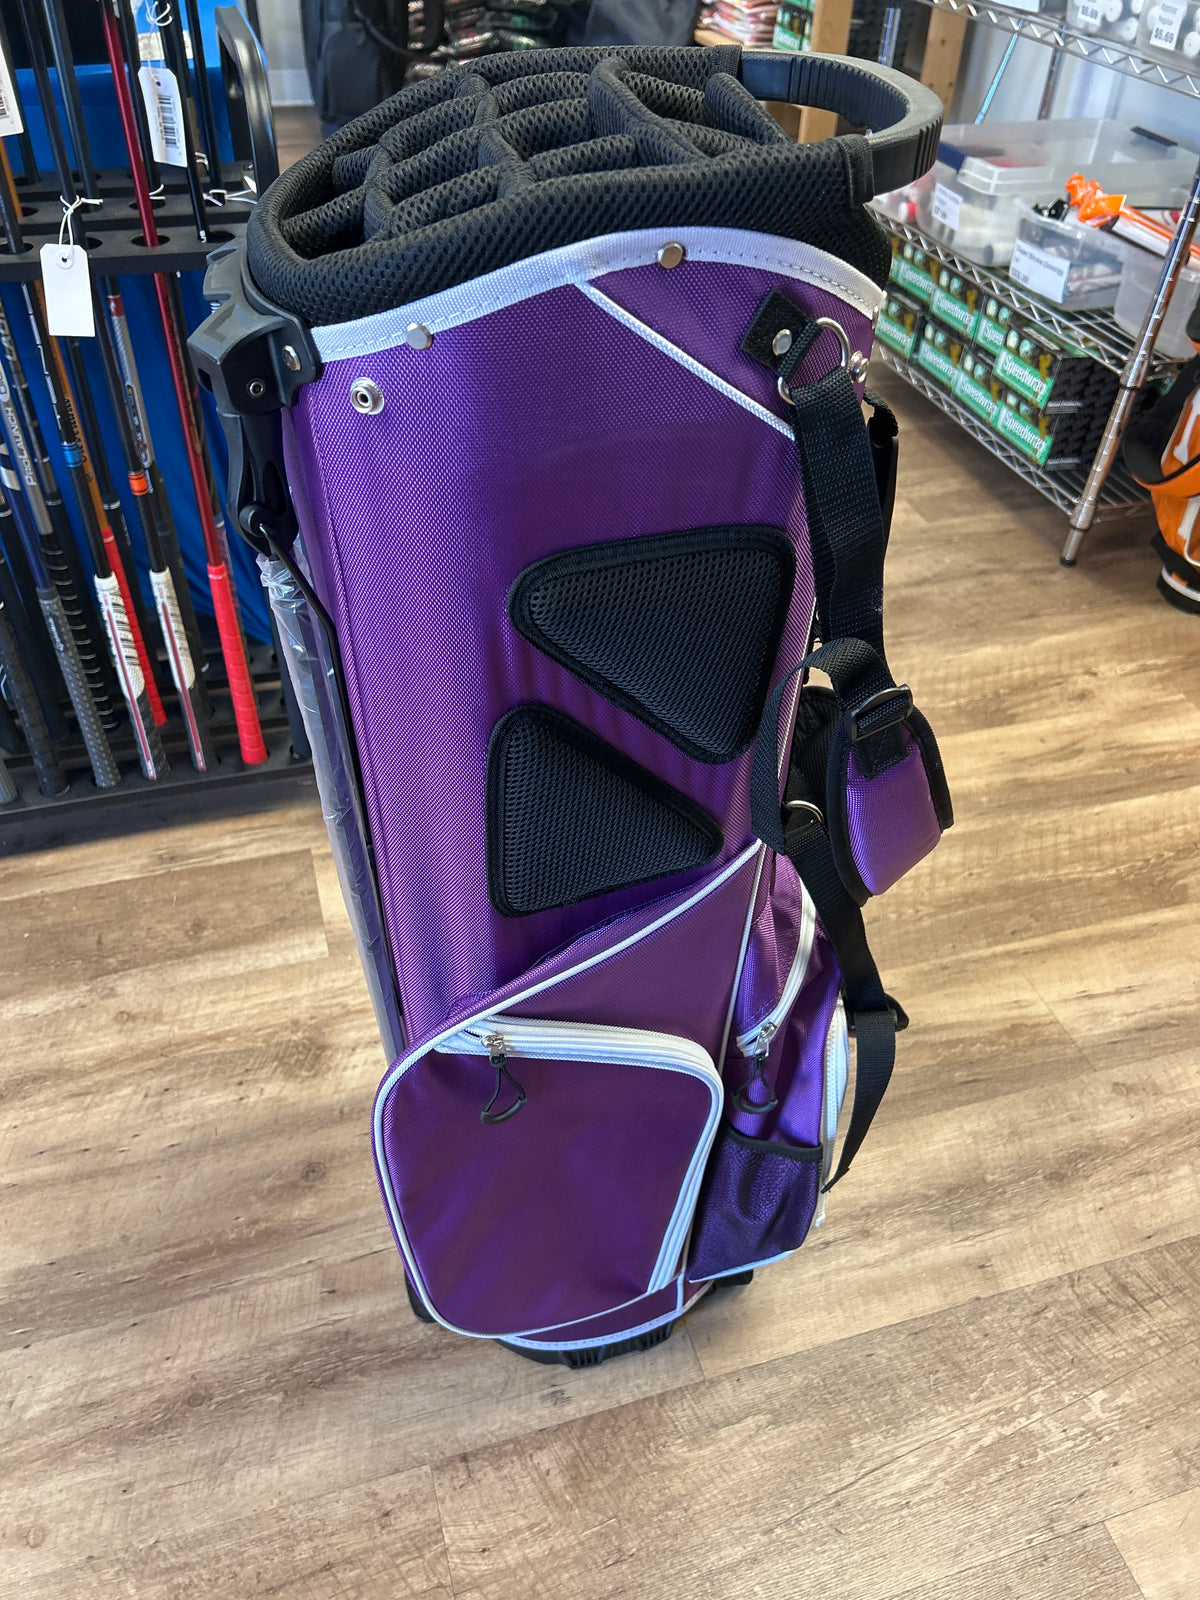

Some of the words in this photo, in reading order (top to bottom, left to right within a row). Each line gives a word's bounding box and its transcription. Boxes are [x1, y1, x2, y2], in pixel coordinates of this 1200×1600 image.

[961, 375, 998, 421] Speedwrap
[1003, 354, 1048, 402] Speedwrap
[1003, 411, 1048, 459] Speedwrap
